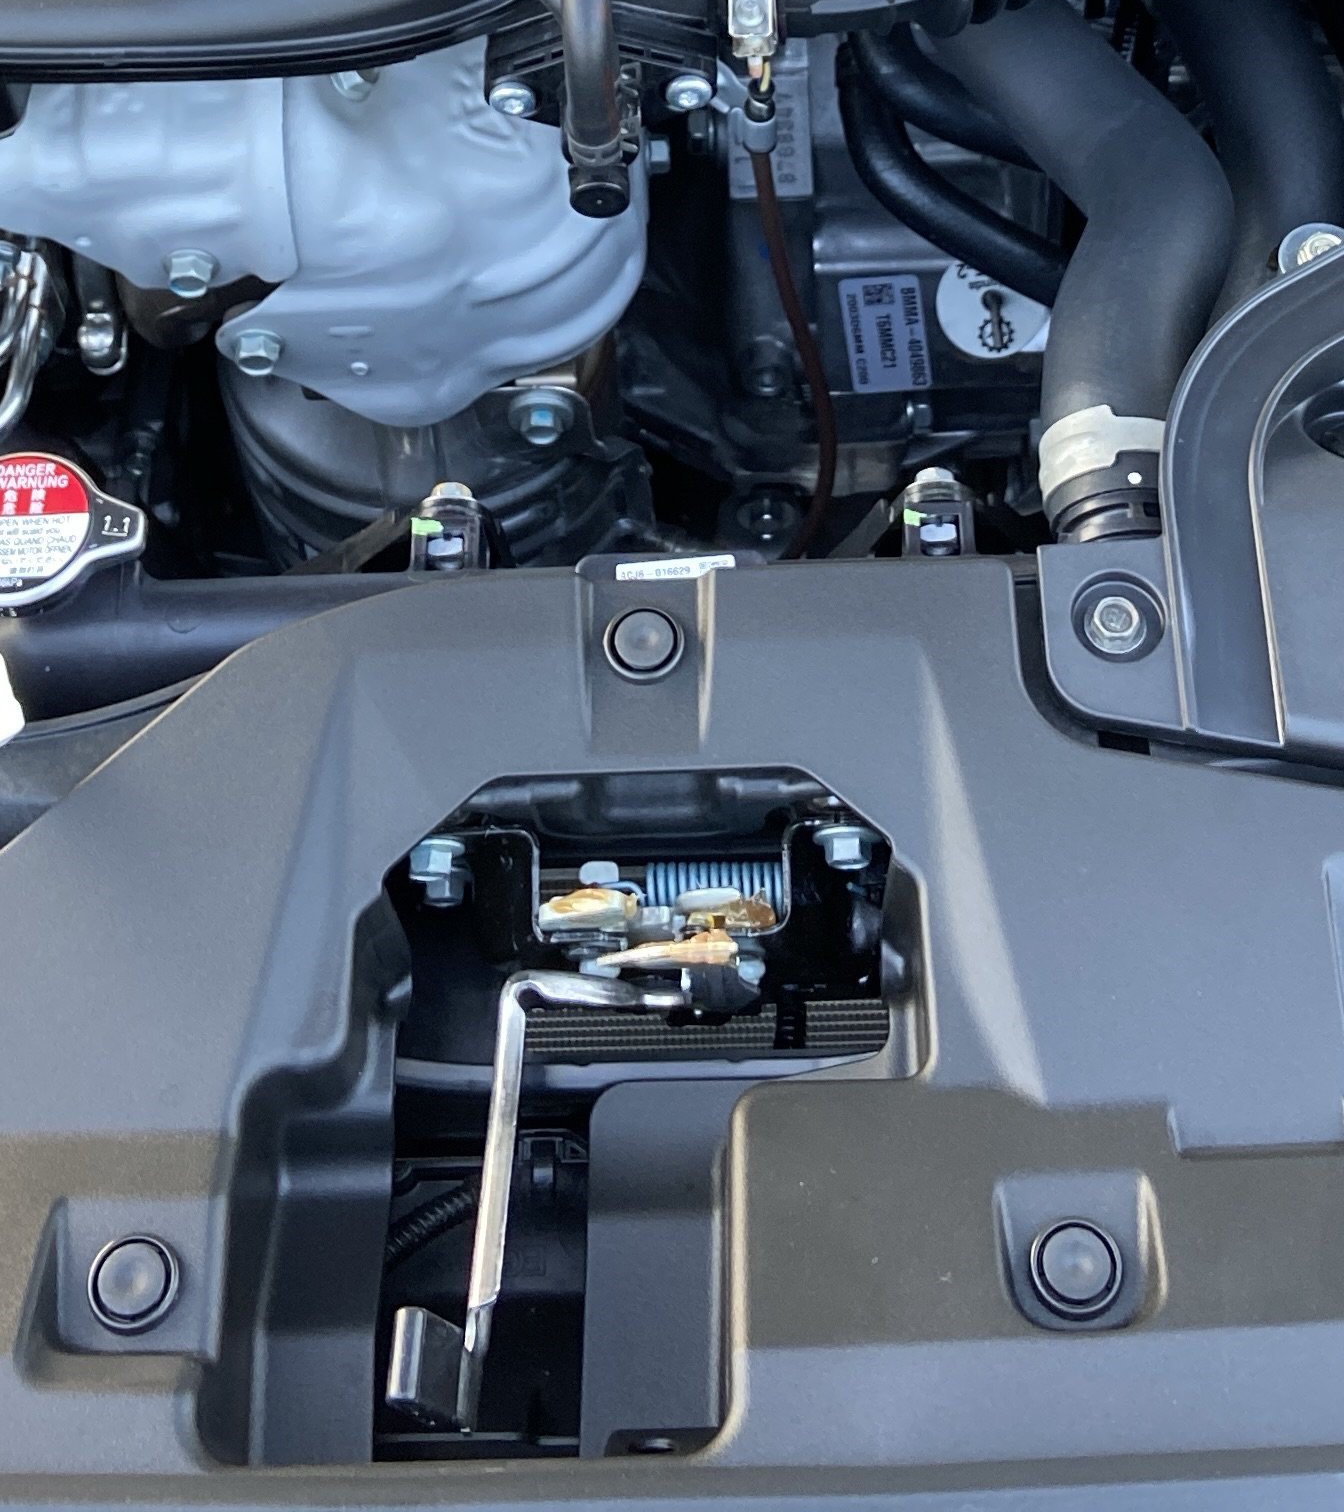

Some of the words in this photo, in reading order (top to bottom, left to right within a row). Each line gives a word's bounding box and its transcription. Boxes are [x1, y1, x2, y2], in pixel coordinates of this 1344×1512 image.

[22, 516, 50, 526] WHEN
[51, 515, 71, 524] HOT
[103, 514, 131, 534] 1.1
